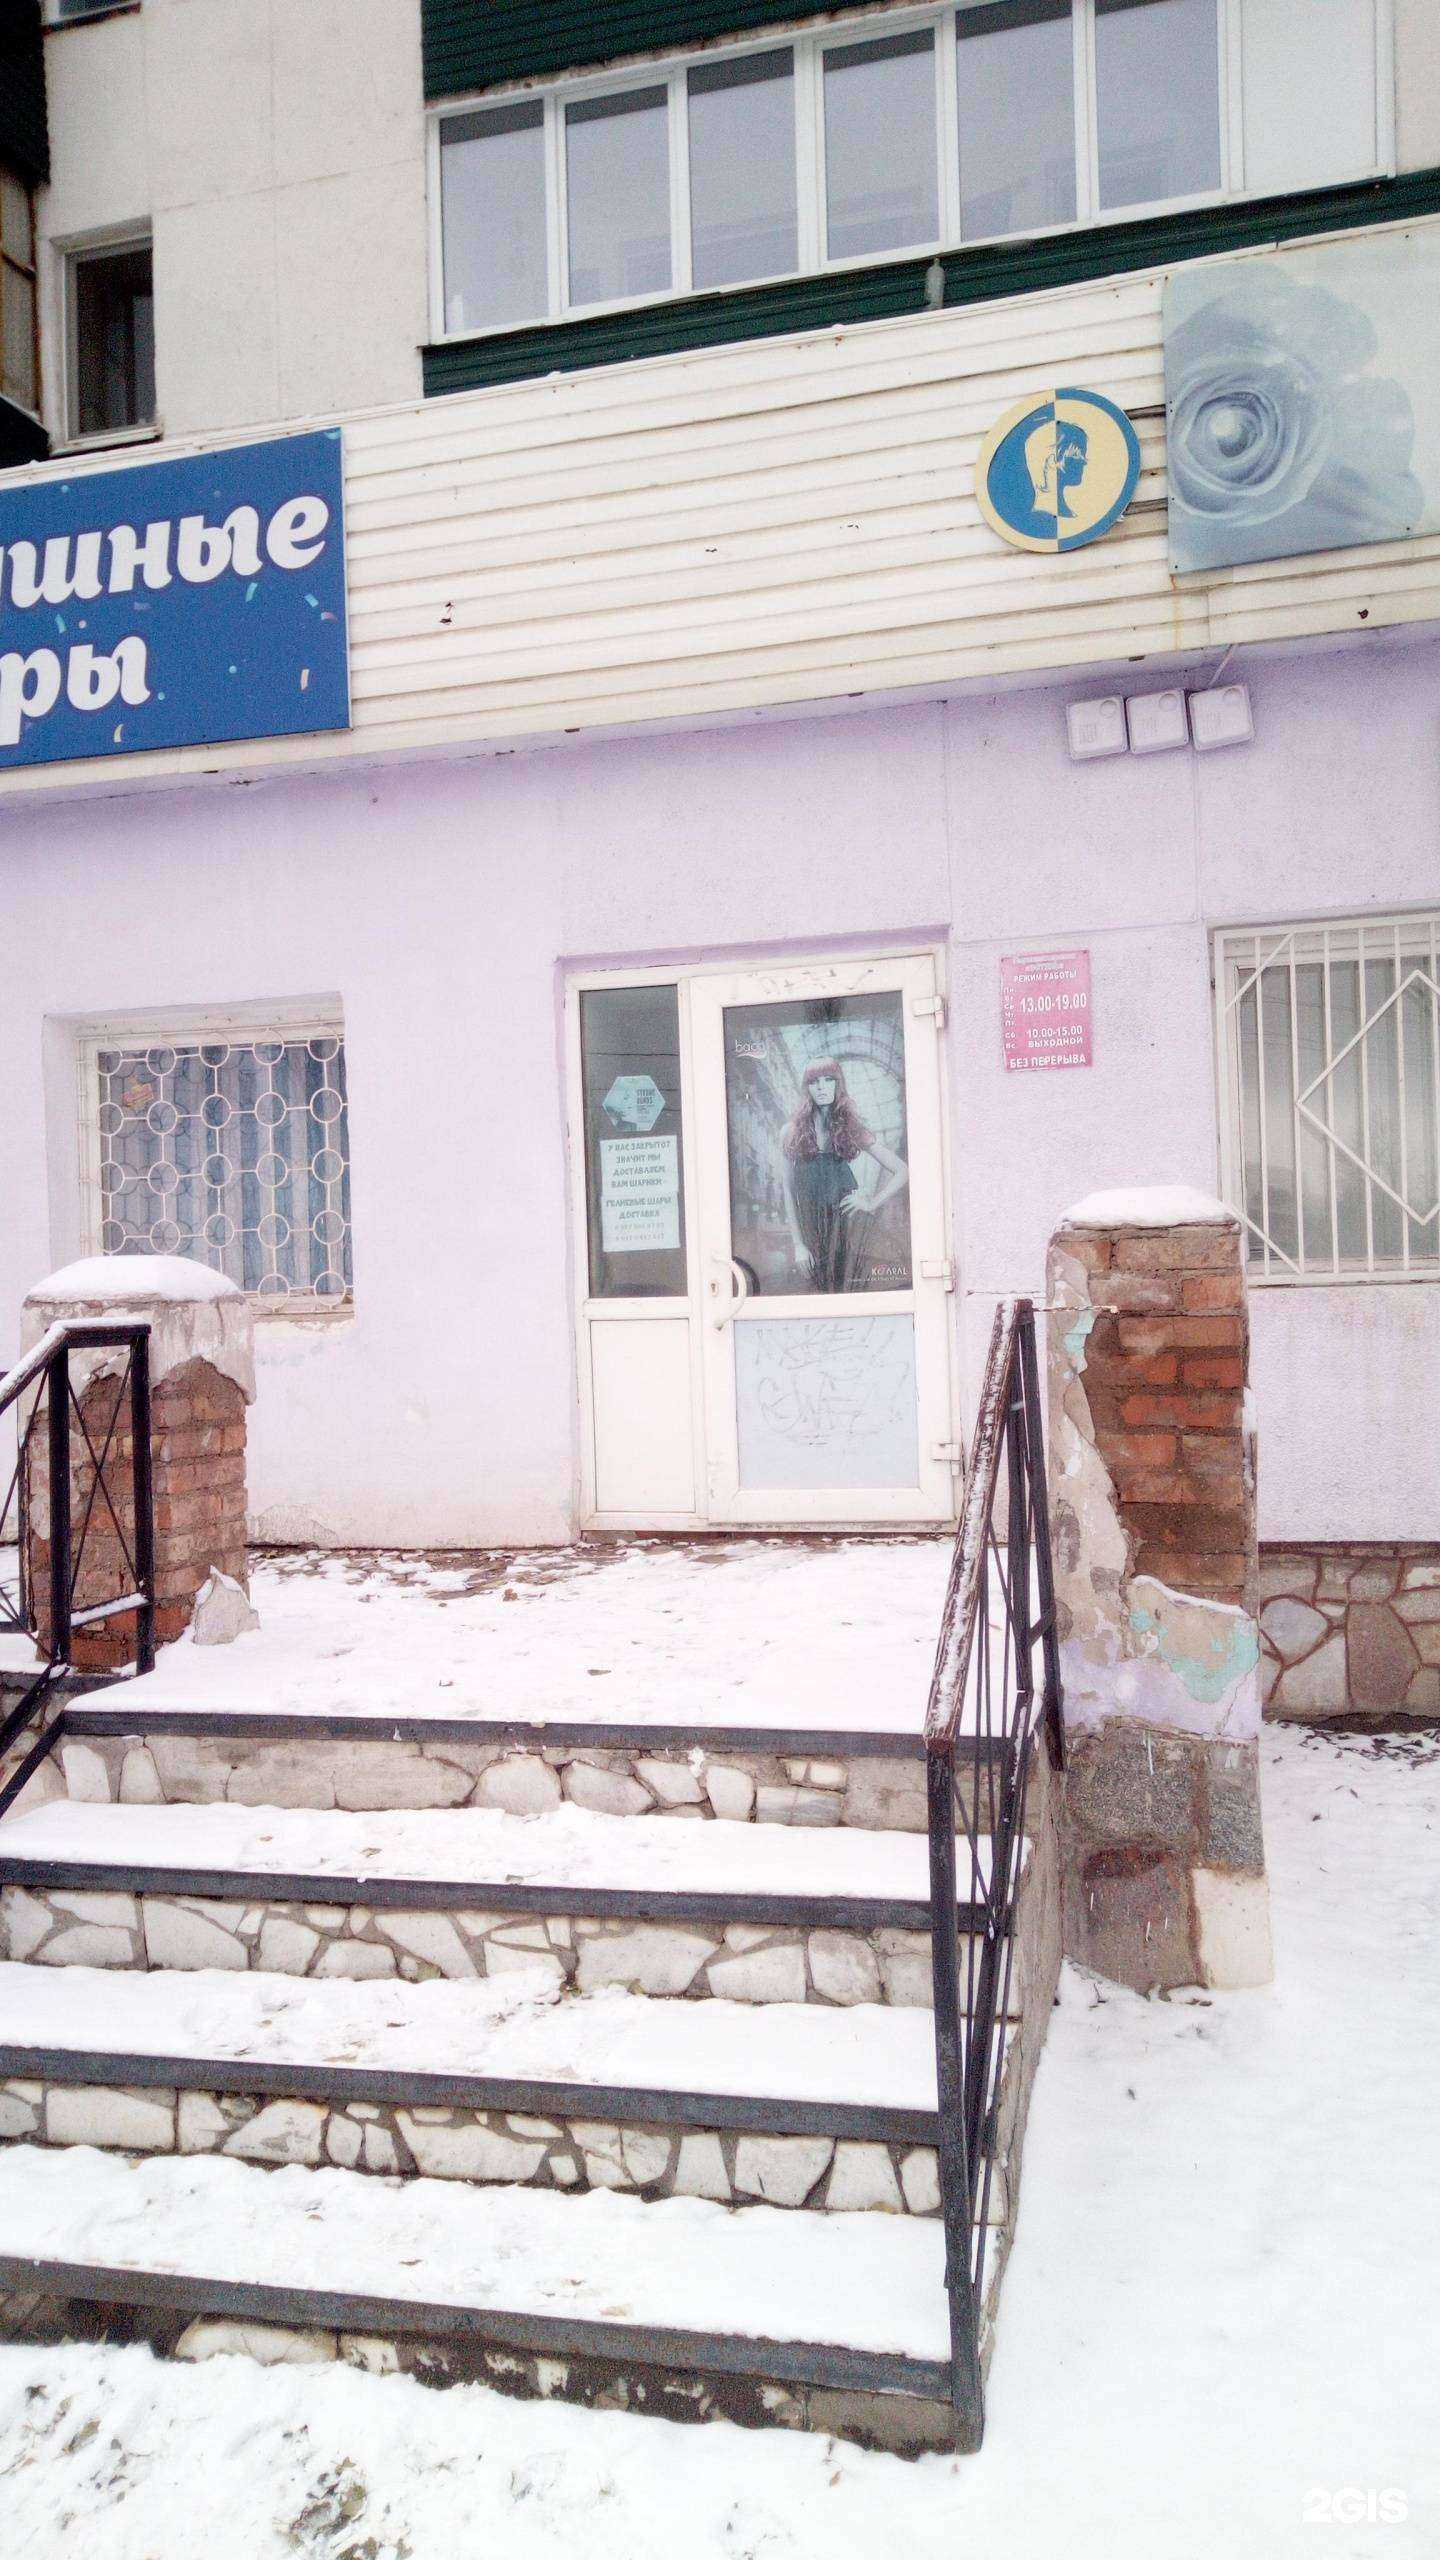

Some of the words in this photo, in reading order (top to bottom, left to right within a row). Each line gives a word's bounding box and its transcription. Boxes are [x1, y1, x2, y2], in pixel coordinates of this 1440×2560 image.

[0, 495, 329, 609] шные
[1014, 972, 1042, 983] РЕЖИМ
[1044, 970, 1077, 981] РАБОТЫ
[1020, 992, 1087, 1014] 13.00-19.00
[1026, 1025, 1083, 1038] 10.00-15.00
[1028, 1036, 1083, 1048] ВЫХОДНОЙ
[1010, 1058, 1028, 1068] БЕЗ
[1031, 1054, 1086, 1067] ПЕРЕРЫВА
